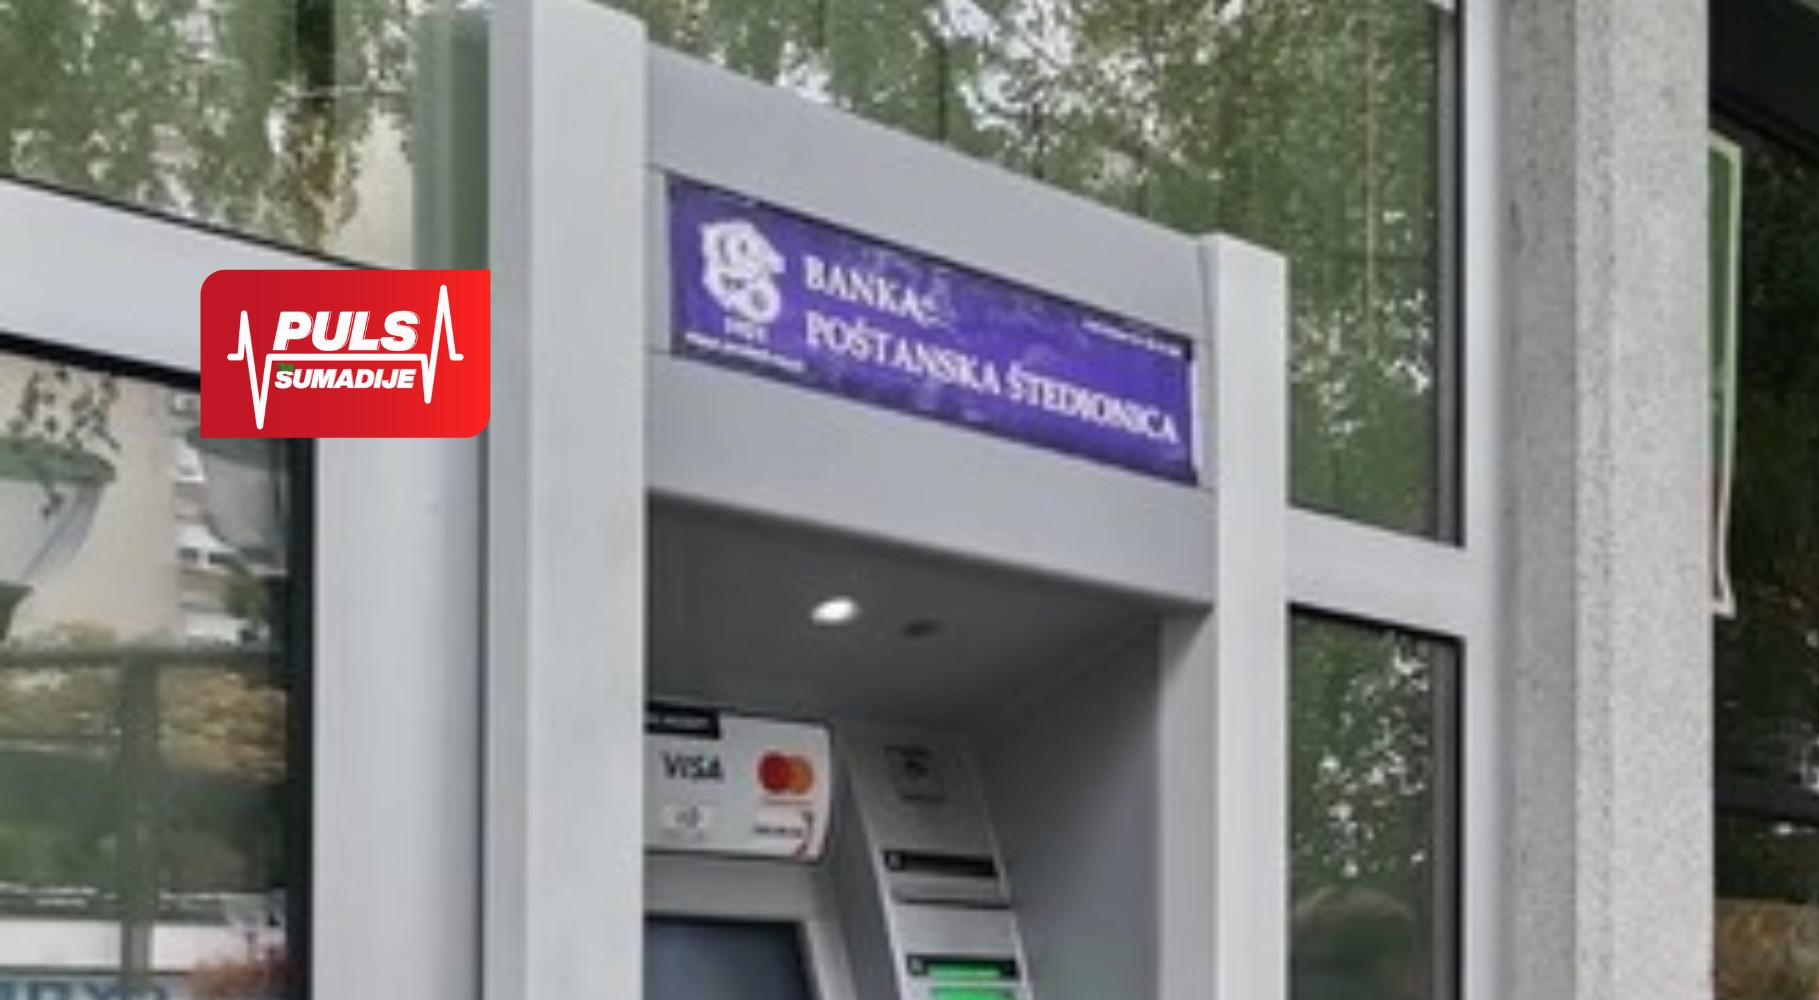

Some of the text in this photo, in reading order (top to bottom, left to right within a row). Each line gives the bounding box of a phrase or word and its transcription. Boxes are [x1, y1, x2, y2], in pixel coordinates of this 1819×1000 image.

[805, 311, 1001, 397] POŠTANSKA
[1004, 361, 1179, 445] ŠTEDIONICA
[660, 751, 724, 782] VISA
